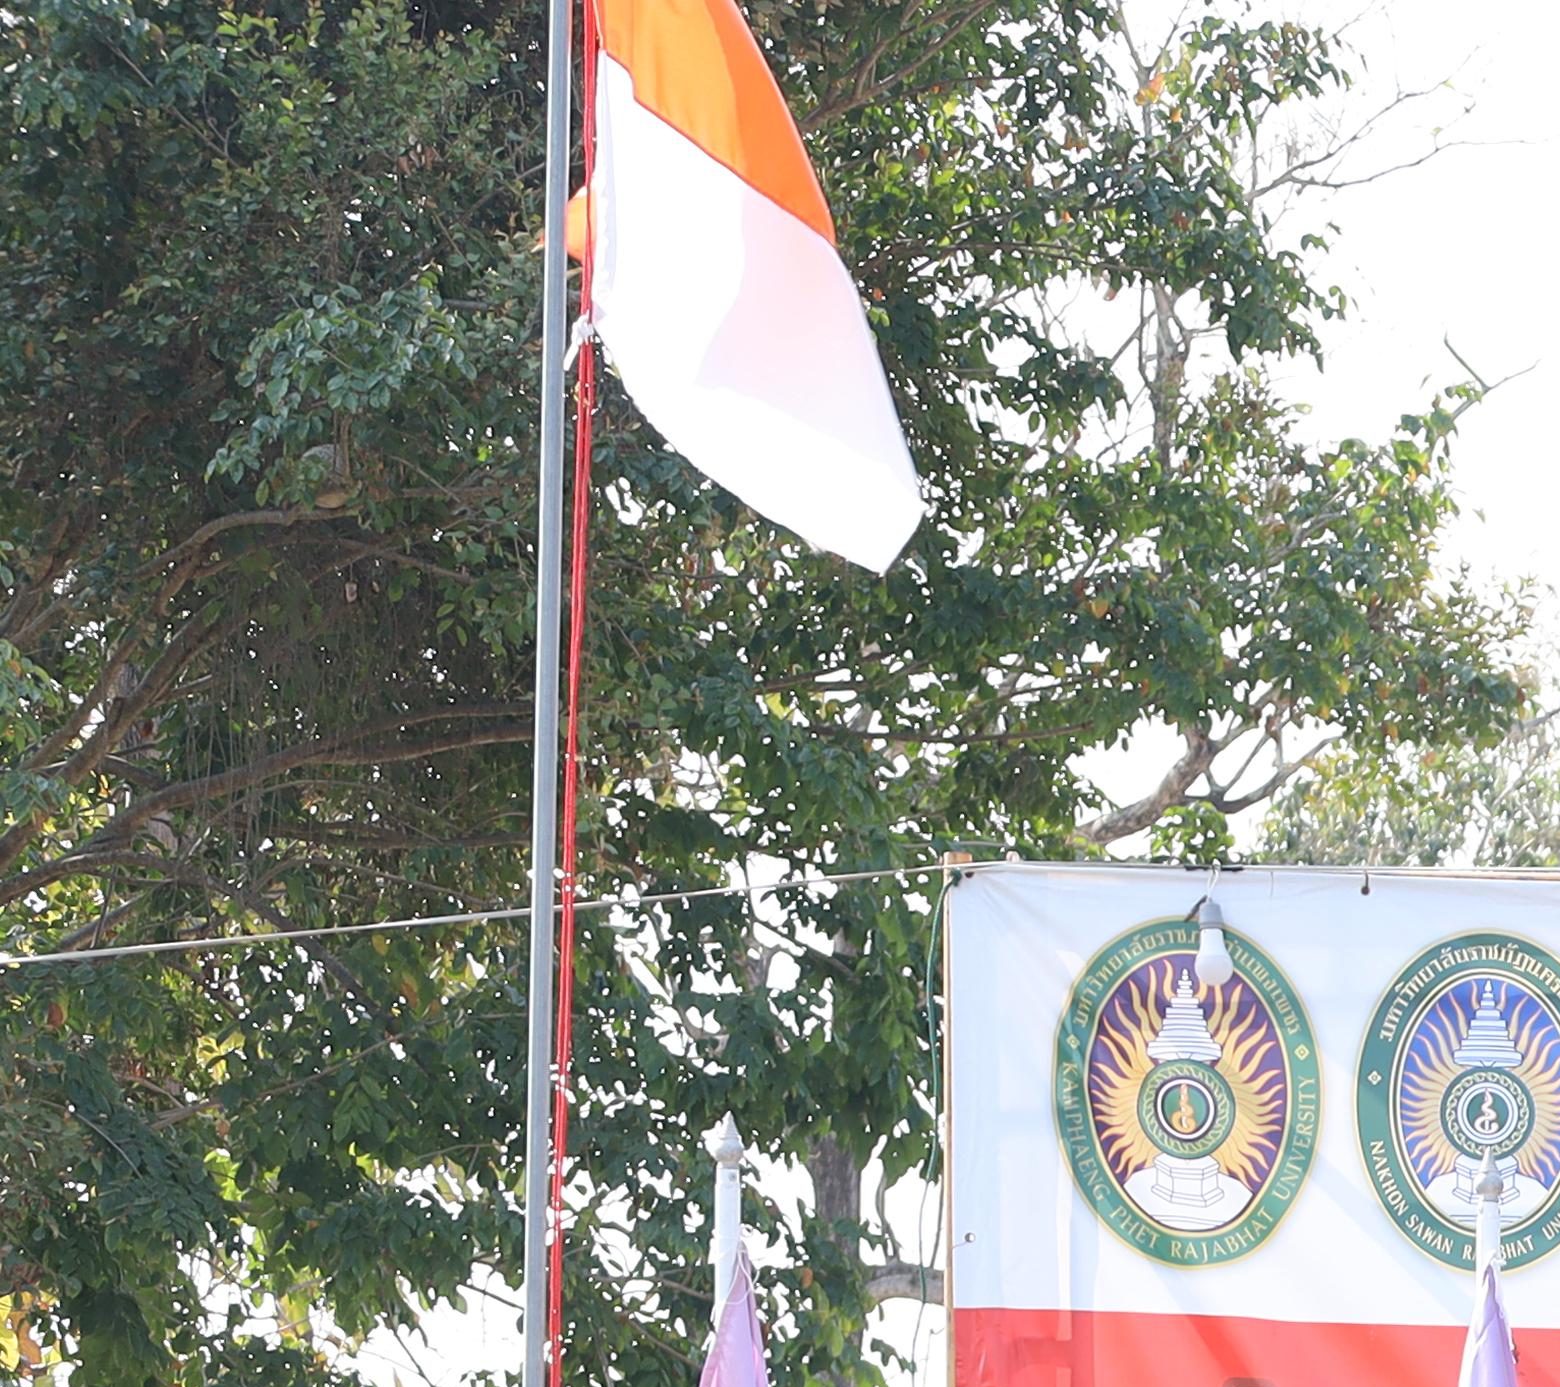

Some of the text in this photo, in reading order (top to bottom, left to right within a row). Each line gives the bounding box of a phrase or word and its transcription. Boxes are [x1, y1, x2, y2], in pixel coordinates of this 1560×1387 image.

[1061, 1061, 1317, 1263] KAMPHAENG PHET RAJABHAT UNIVERSITY
[1370, 1140, 1408, 1217] NAKHON
[1404, 1213, 1455, 1255] SAWAN
[1462, 1234, 1535, 1261] RBHAT
